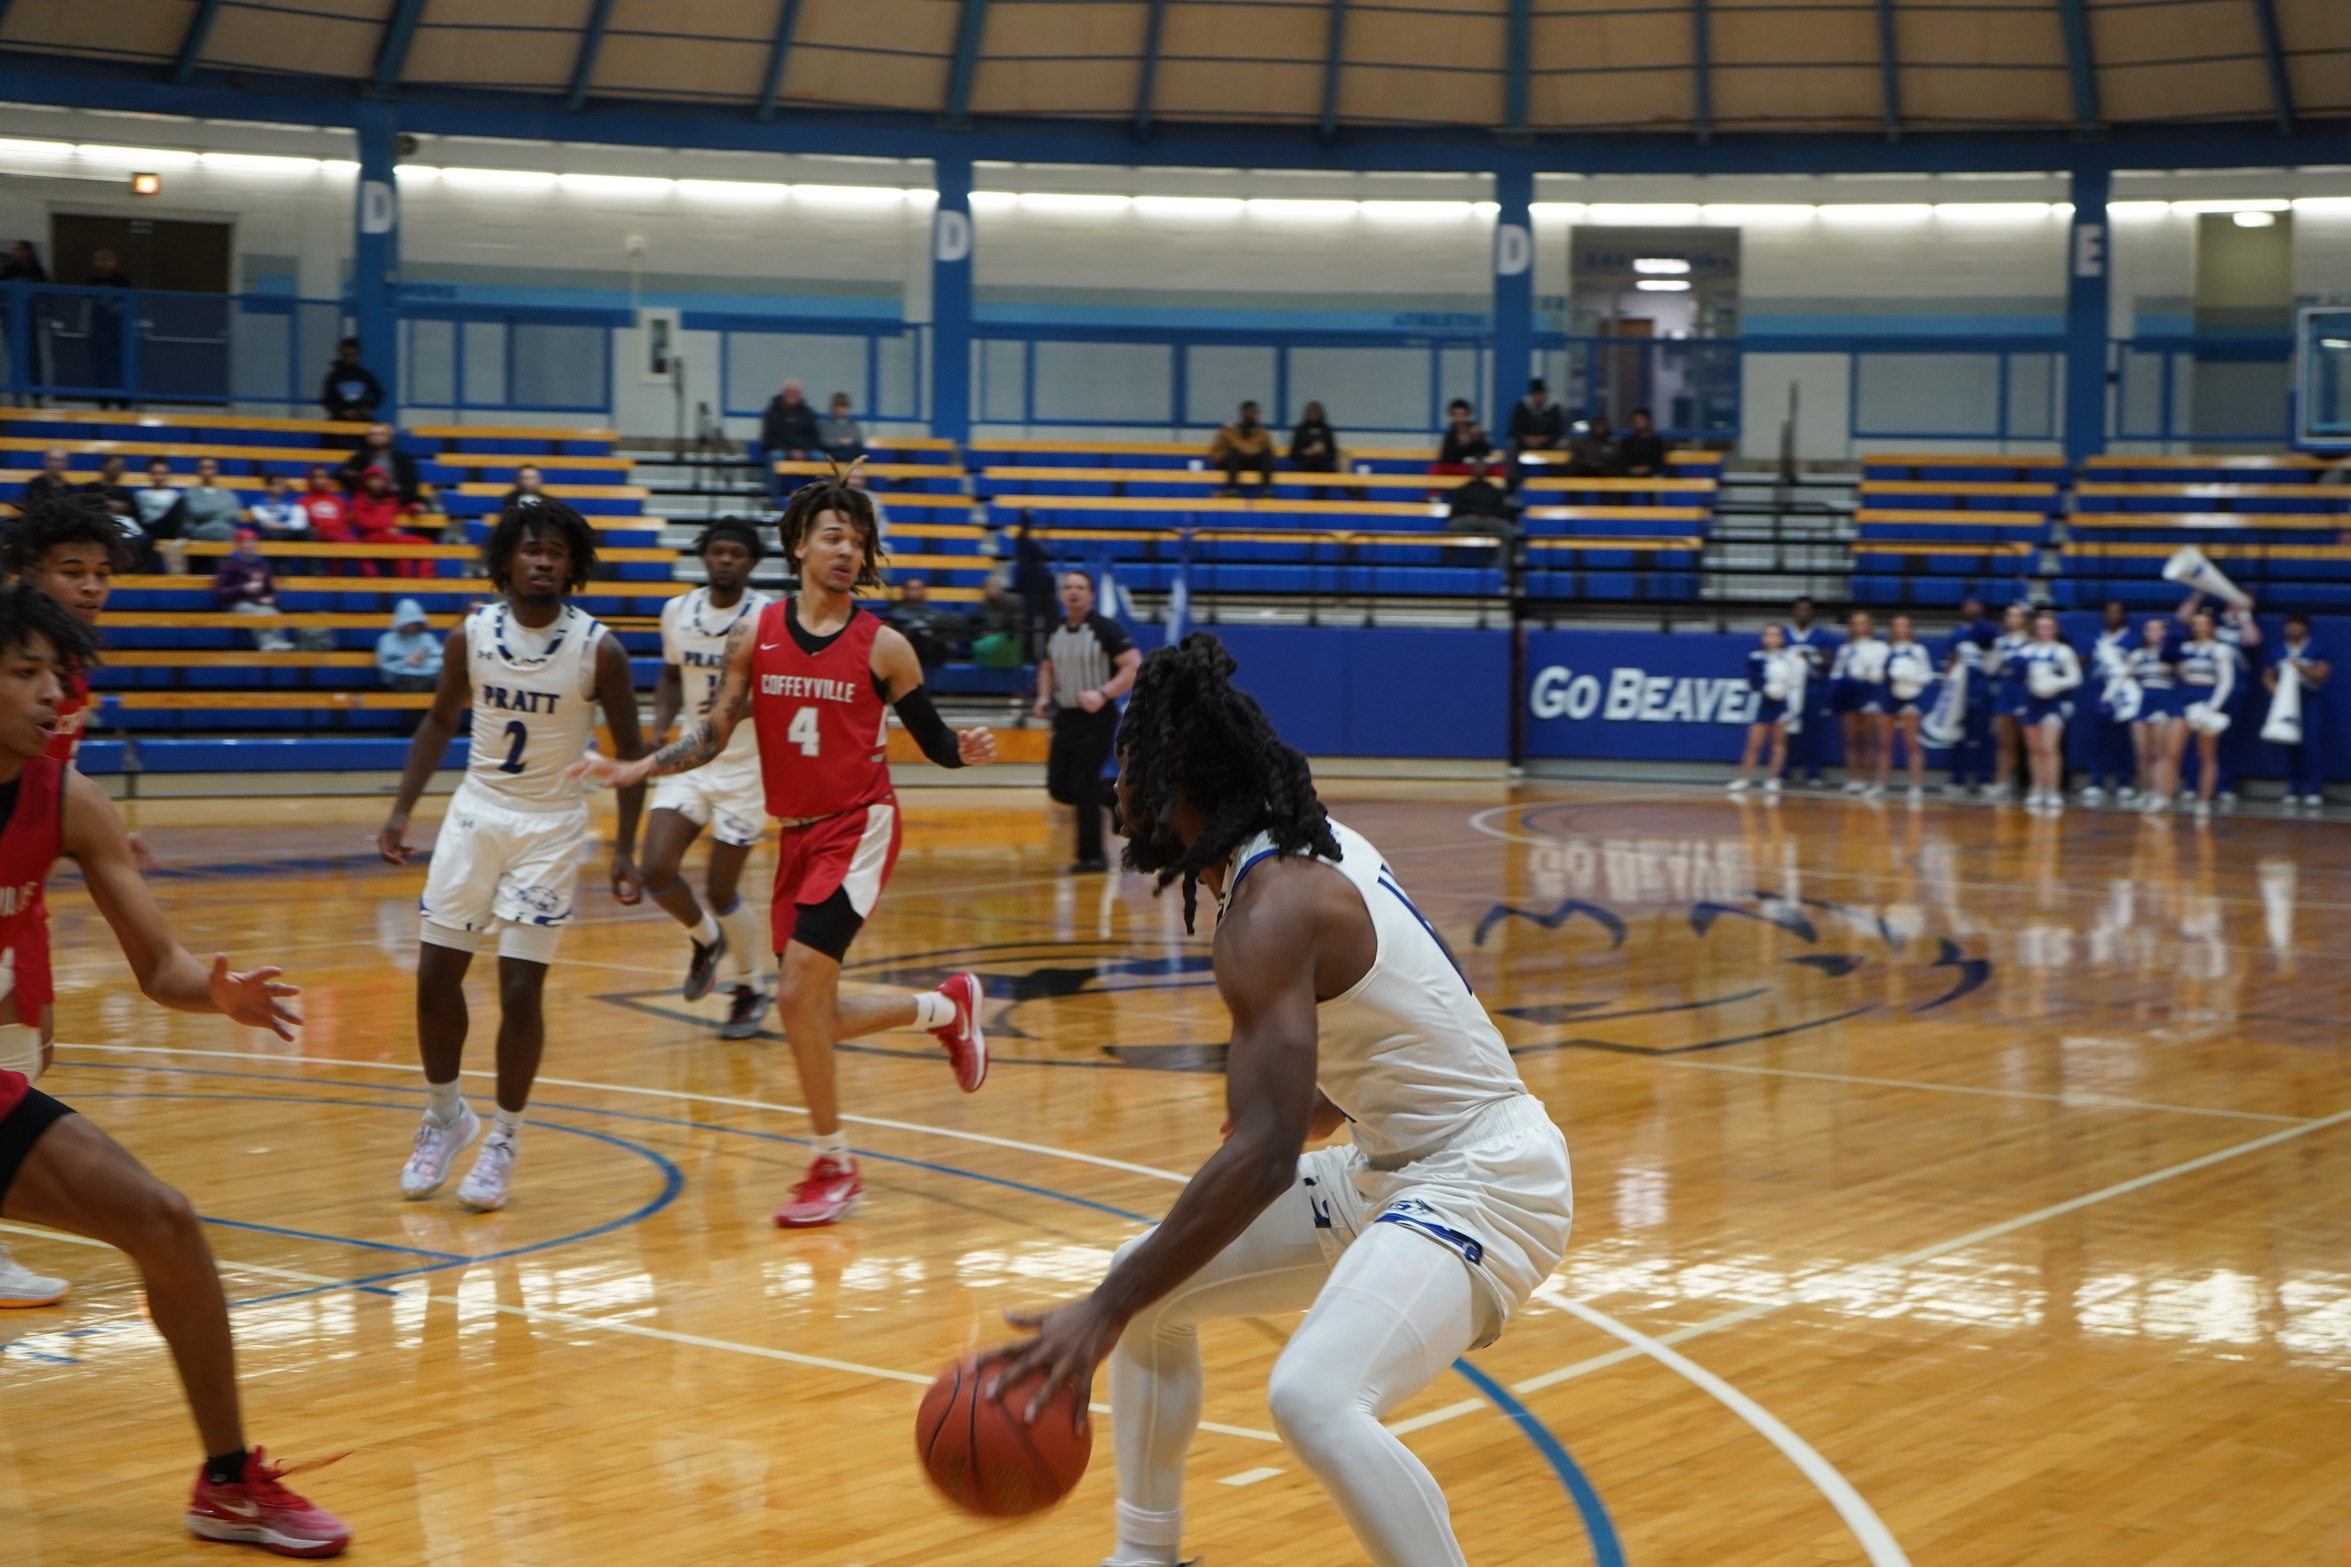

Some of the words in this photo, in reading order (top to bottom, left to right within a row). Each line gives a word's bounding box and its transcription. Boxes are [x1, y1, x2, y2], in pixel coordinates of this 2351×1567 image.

[362, 180, 394, 234] D
[937, 208, 971, 261] D
[1499, 223, 1531, 276] D
[2077, 223, 2103, 277] E
[483, 684, 561, 714] PRATT
[760, 673, 856, 703] COFFEYVILLE
[497, 720, 528, 774] 2
[787, 706, 820, 757] 4
